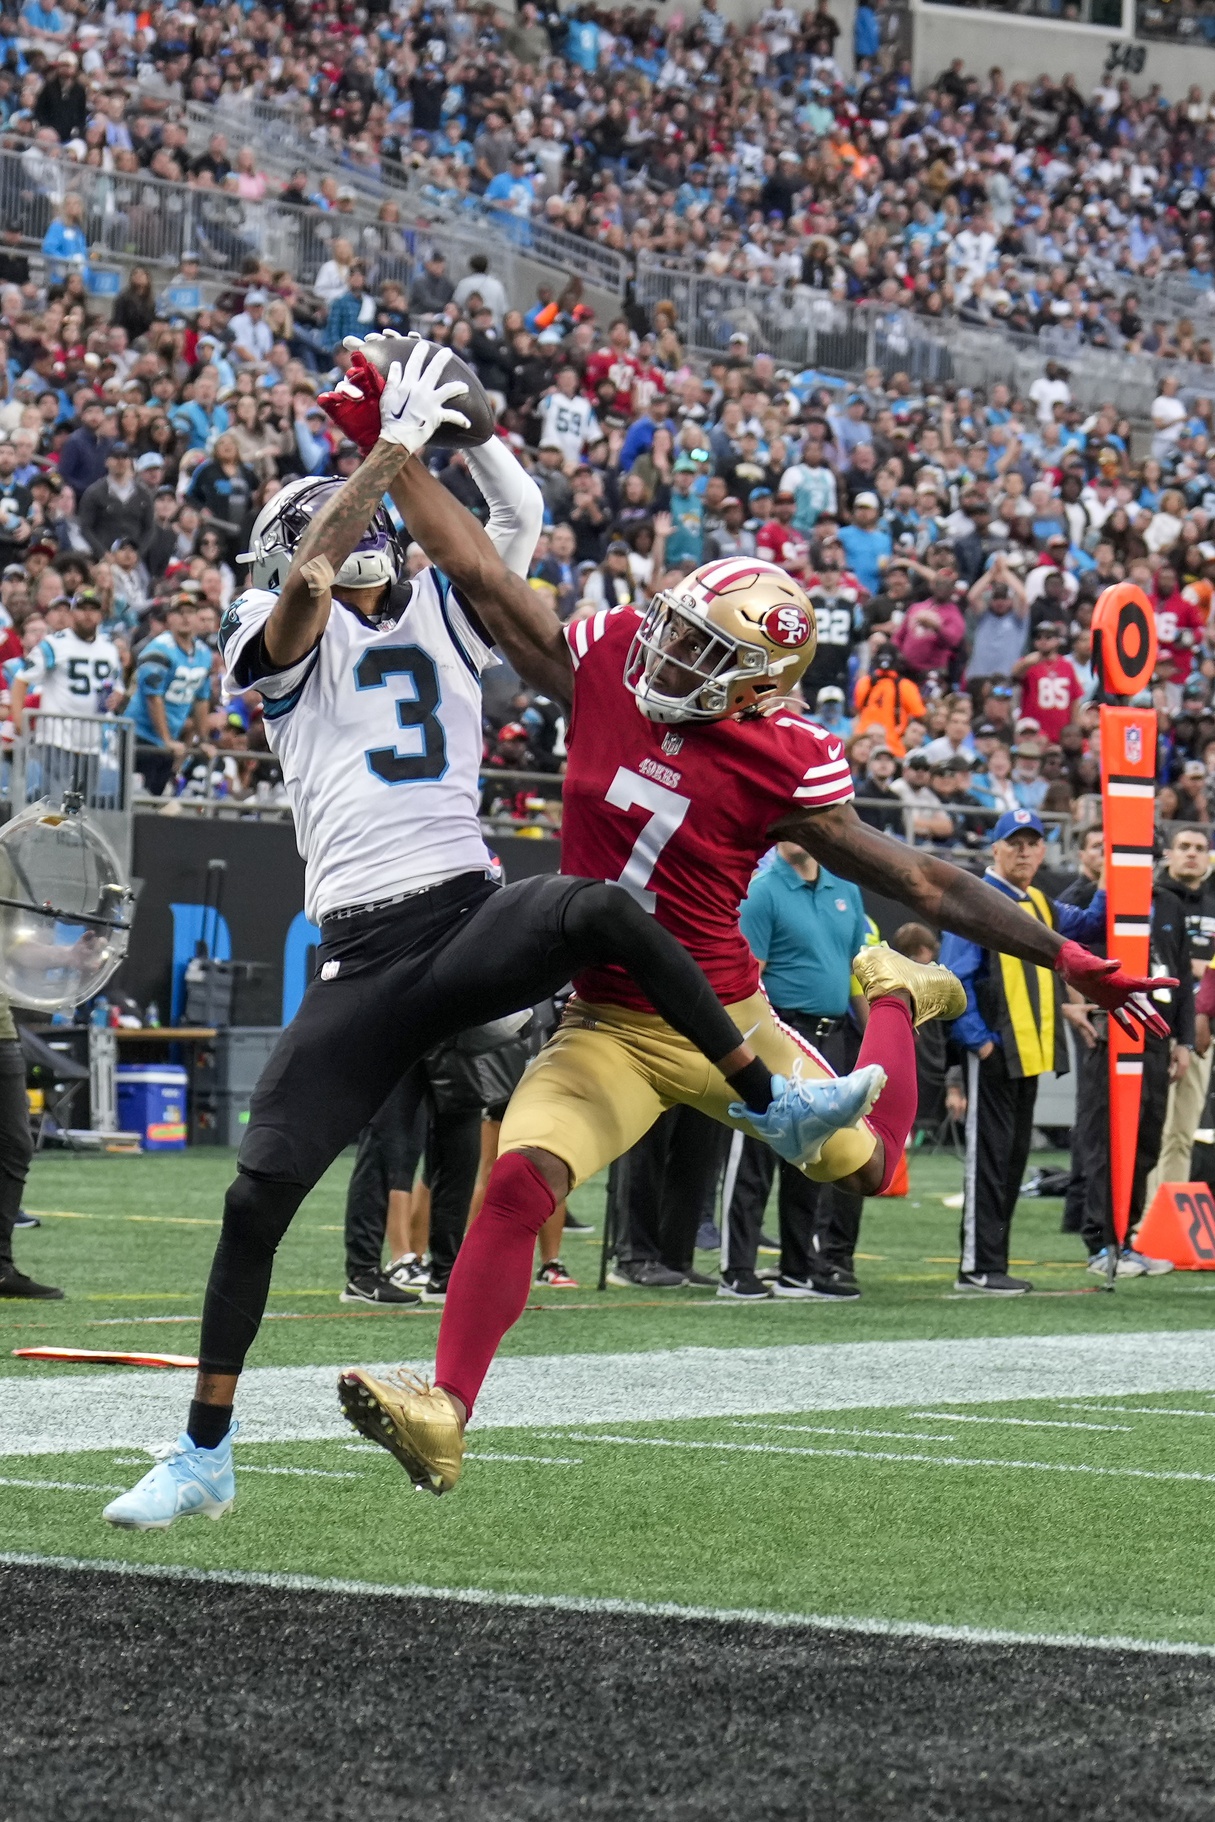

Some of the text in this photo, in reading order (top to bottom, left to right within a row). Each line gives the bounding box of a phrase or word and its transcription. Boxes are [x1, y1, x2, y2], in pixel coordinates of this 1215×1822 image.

[557, 407, 581, 436] 59
[816, 608, 851, 645] 22
[68, 658, 110, 695] 59
[1038, 676, 1070, 709] 85
[353, 643, 450, 786] 3
[638, 758, 681, 789] 49ERS
[604, 765, 690, 915] 7
